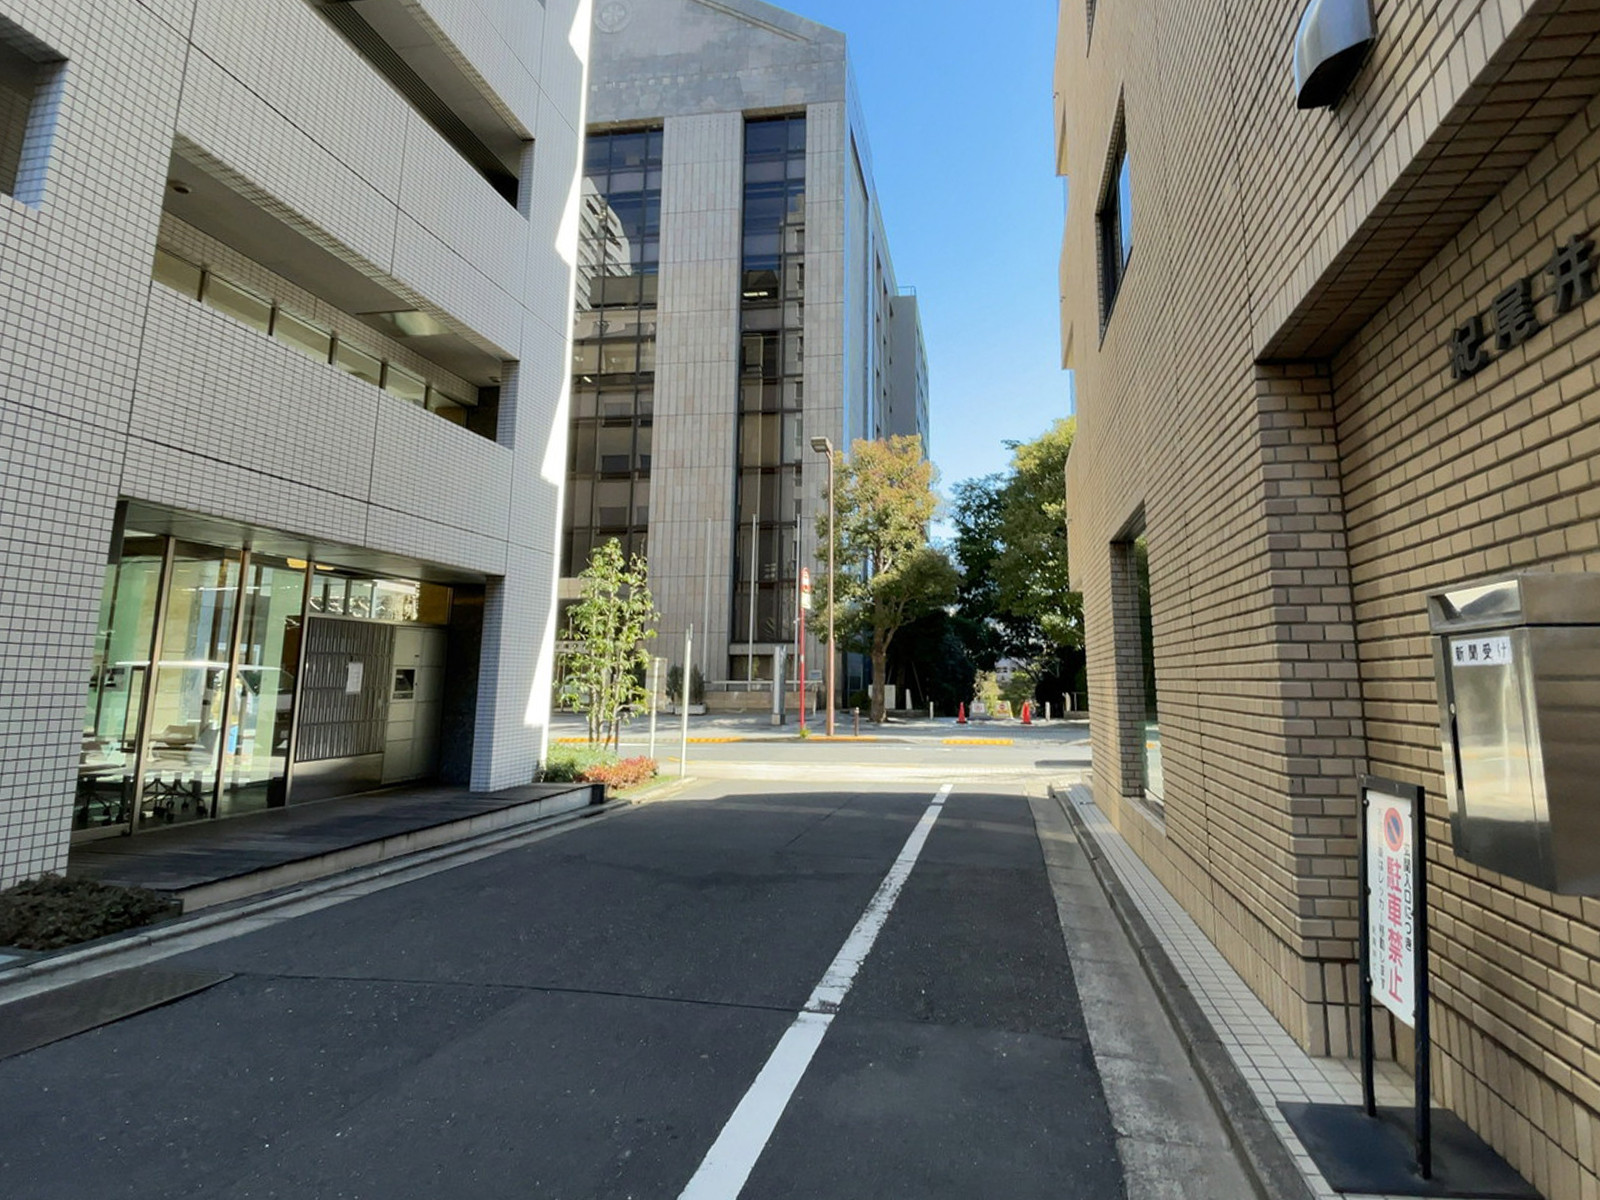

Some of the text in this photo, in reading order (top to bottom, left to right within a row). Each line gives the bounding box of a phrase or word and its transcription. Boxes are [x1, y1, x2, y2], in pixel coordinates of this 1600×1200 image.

[1452, 234, 1593, 379] 紀尾井
[1455, 642, 1507, 662] 新聞受け
[1386, 856, 1404, 1004] 駐車禁止
